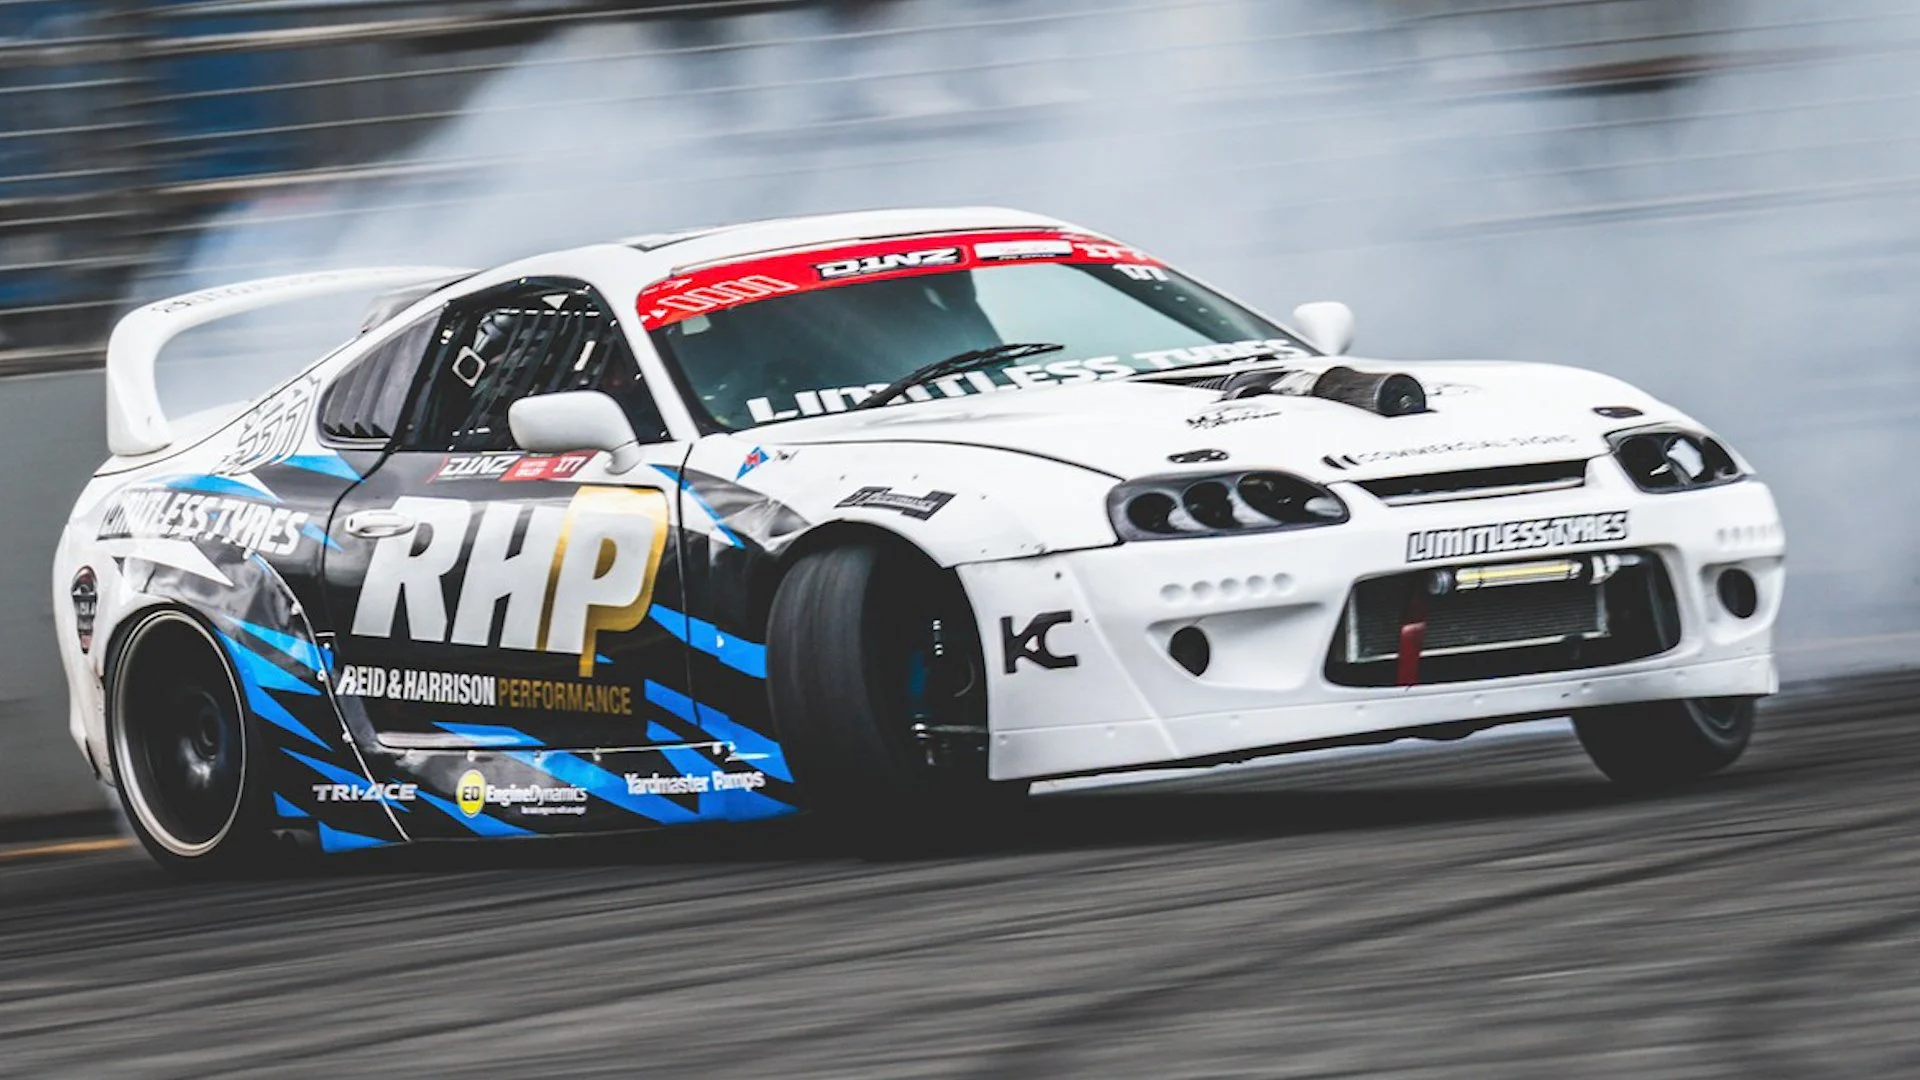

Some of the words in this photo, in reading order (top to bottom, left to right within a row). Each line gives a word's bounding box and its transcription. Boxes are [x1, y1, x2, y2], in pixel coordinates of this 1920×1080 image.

[351, 486, 669, 677] RHP
[499, 678, 633, 716] PERFORMANCE
[624, 772, 710, 796] Yardmaster
